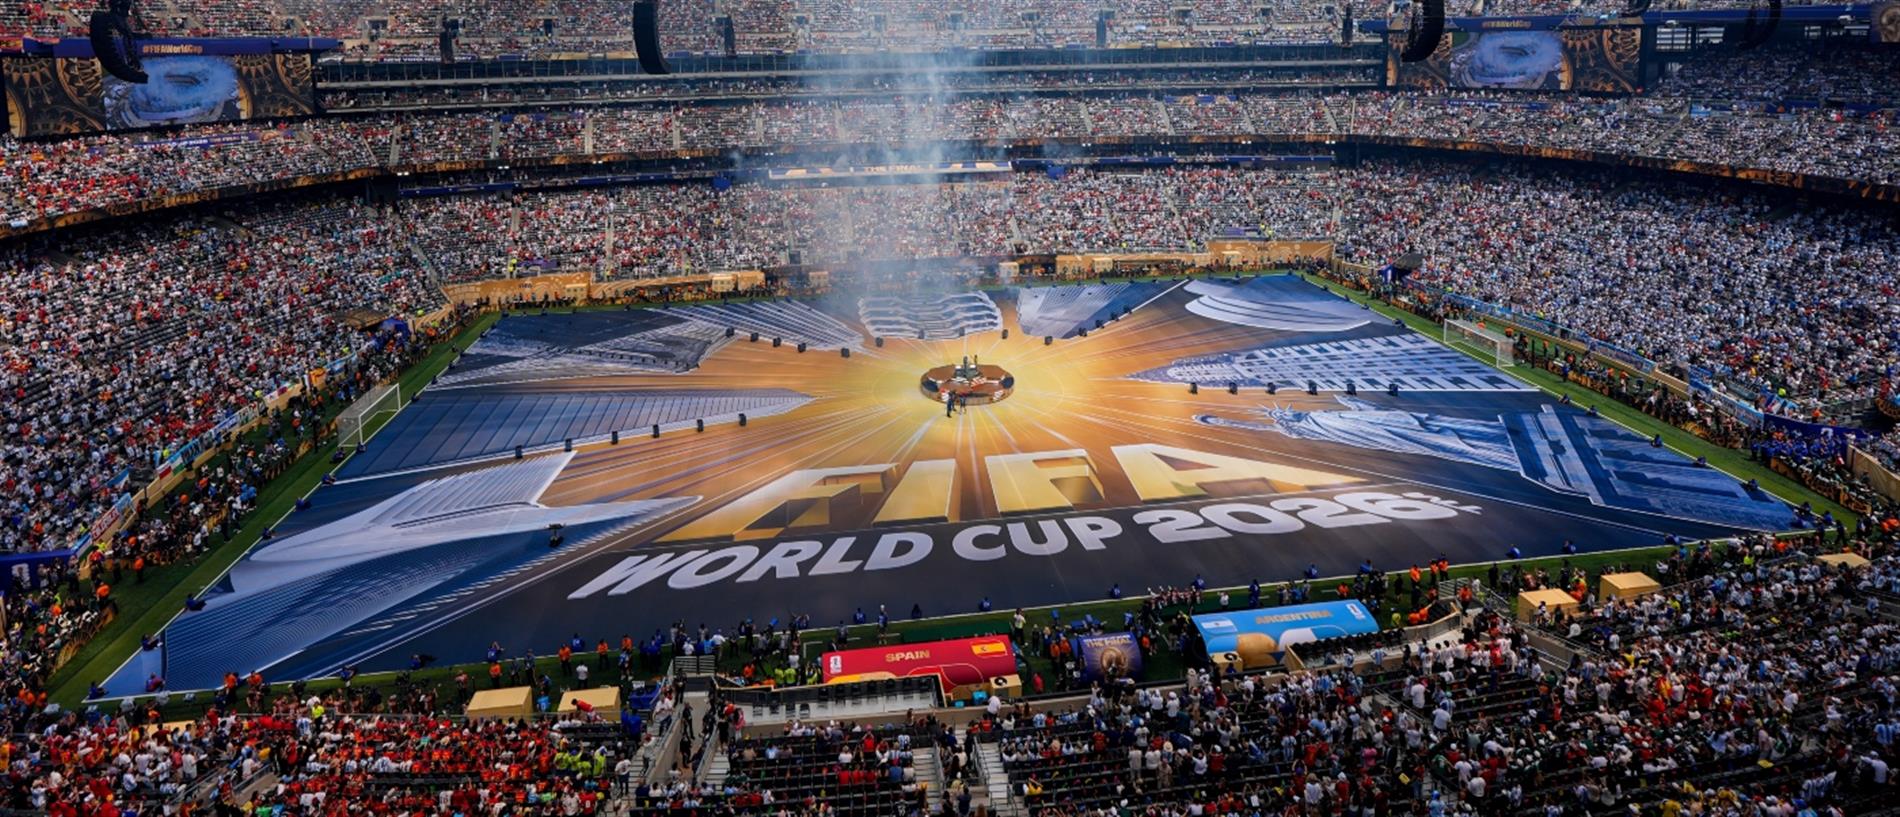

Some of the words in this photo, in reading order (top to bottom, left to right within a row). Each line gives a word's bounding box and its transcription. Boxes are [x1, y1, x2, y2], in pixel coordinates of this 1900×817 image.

[653, 443, 1373, 542] FIFA
[567, 532, 934, 599] WORLD
[952, 516, 1122, 561] CUP
[1255, 610, 1334, 625] ARGENTINA
[886, 649, 932, 664] SPAIN
